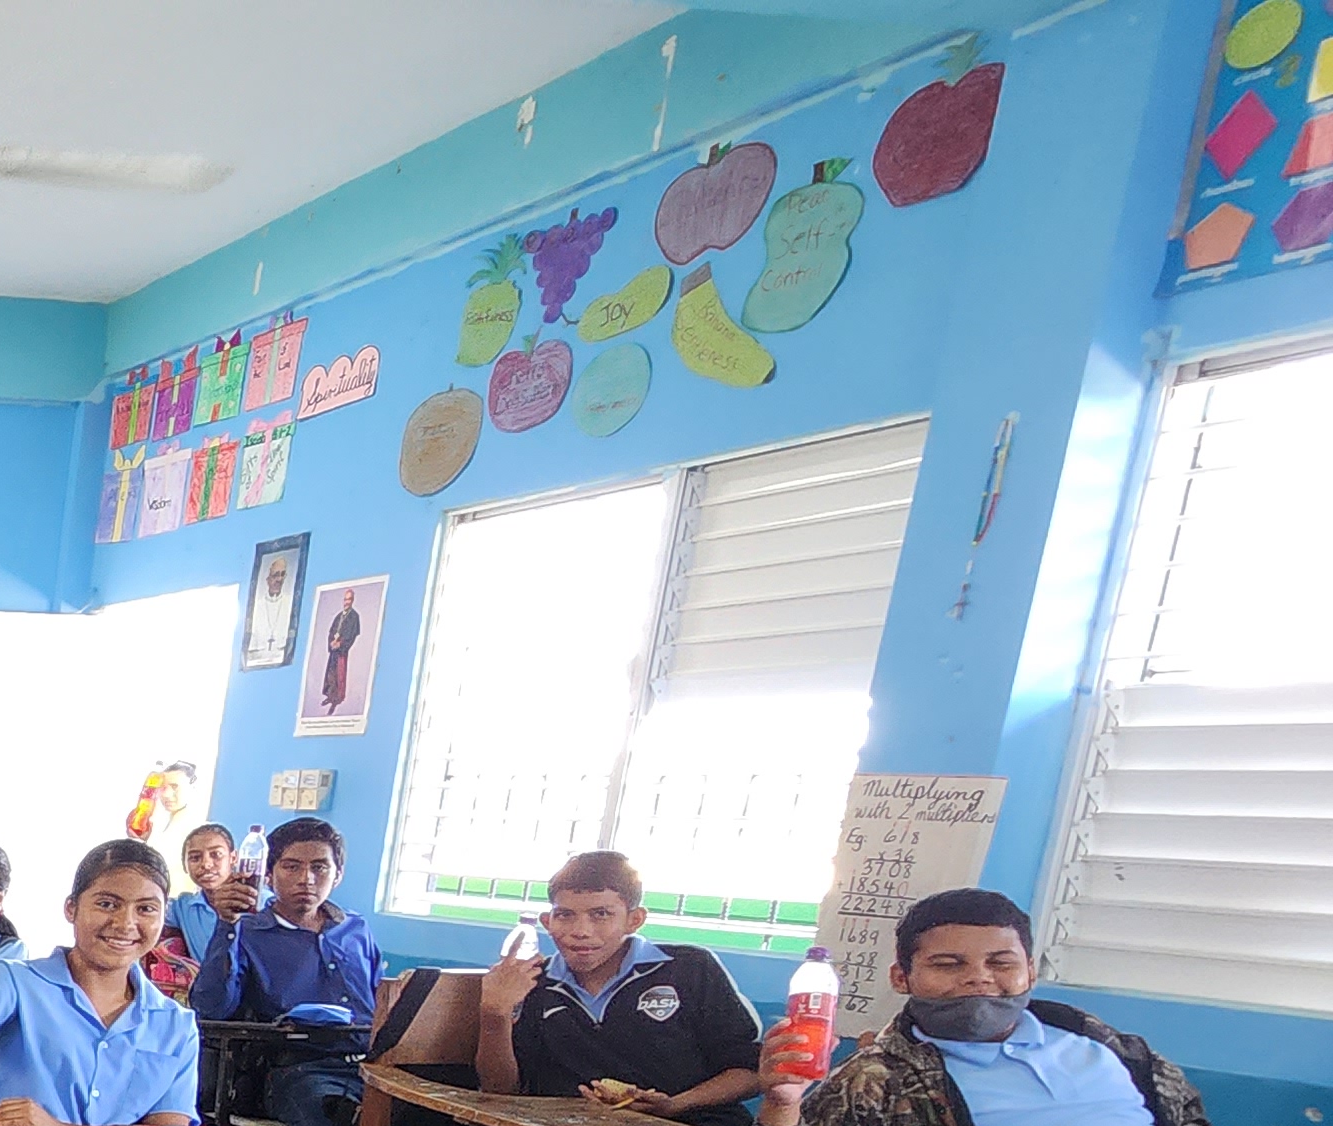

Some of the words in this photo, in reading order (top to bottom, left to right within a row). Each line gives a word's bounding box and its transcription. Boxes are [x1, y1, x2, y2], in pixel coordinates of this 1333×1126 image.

[600, 301, 636, 329] JOY
[302, 355, 376, 414] Spirituality
[863, 776, 985, 812] Multiplying
[854, 800, 892, 820] with
[897, 801, 914, 821] 2
[914, 802, 996, 828] multipliers
[883, 827, 921, 845] 618
[894, 847, 915, 862] 36
[861, 861, 913, 879] 3708
[838, 927, 880, 946] 1689
[856, 951, 879, 966] 58
[636, 998, 680, 1011] DASH
